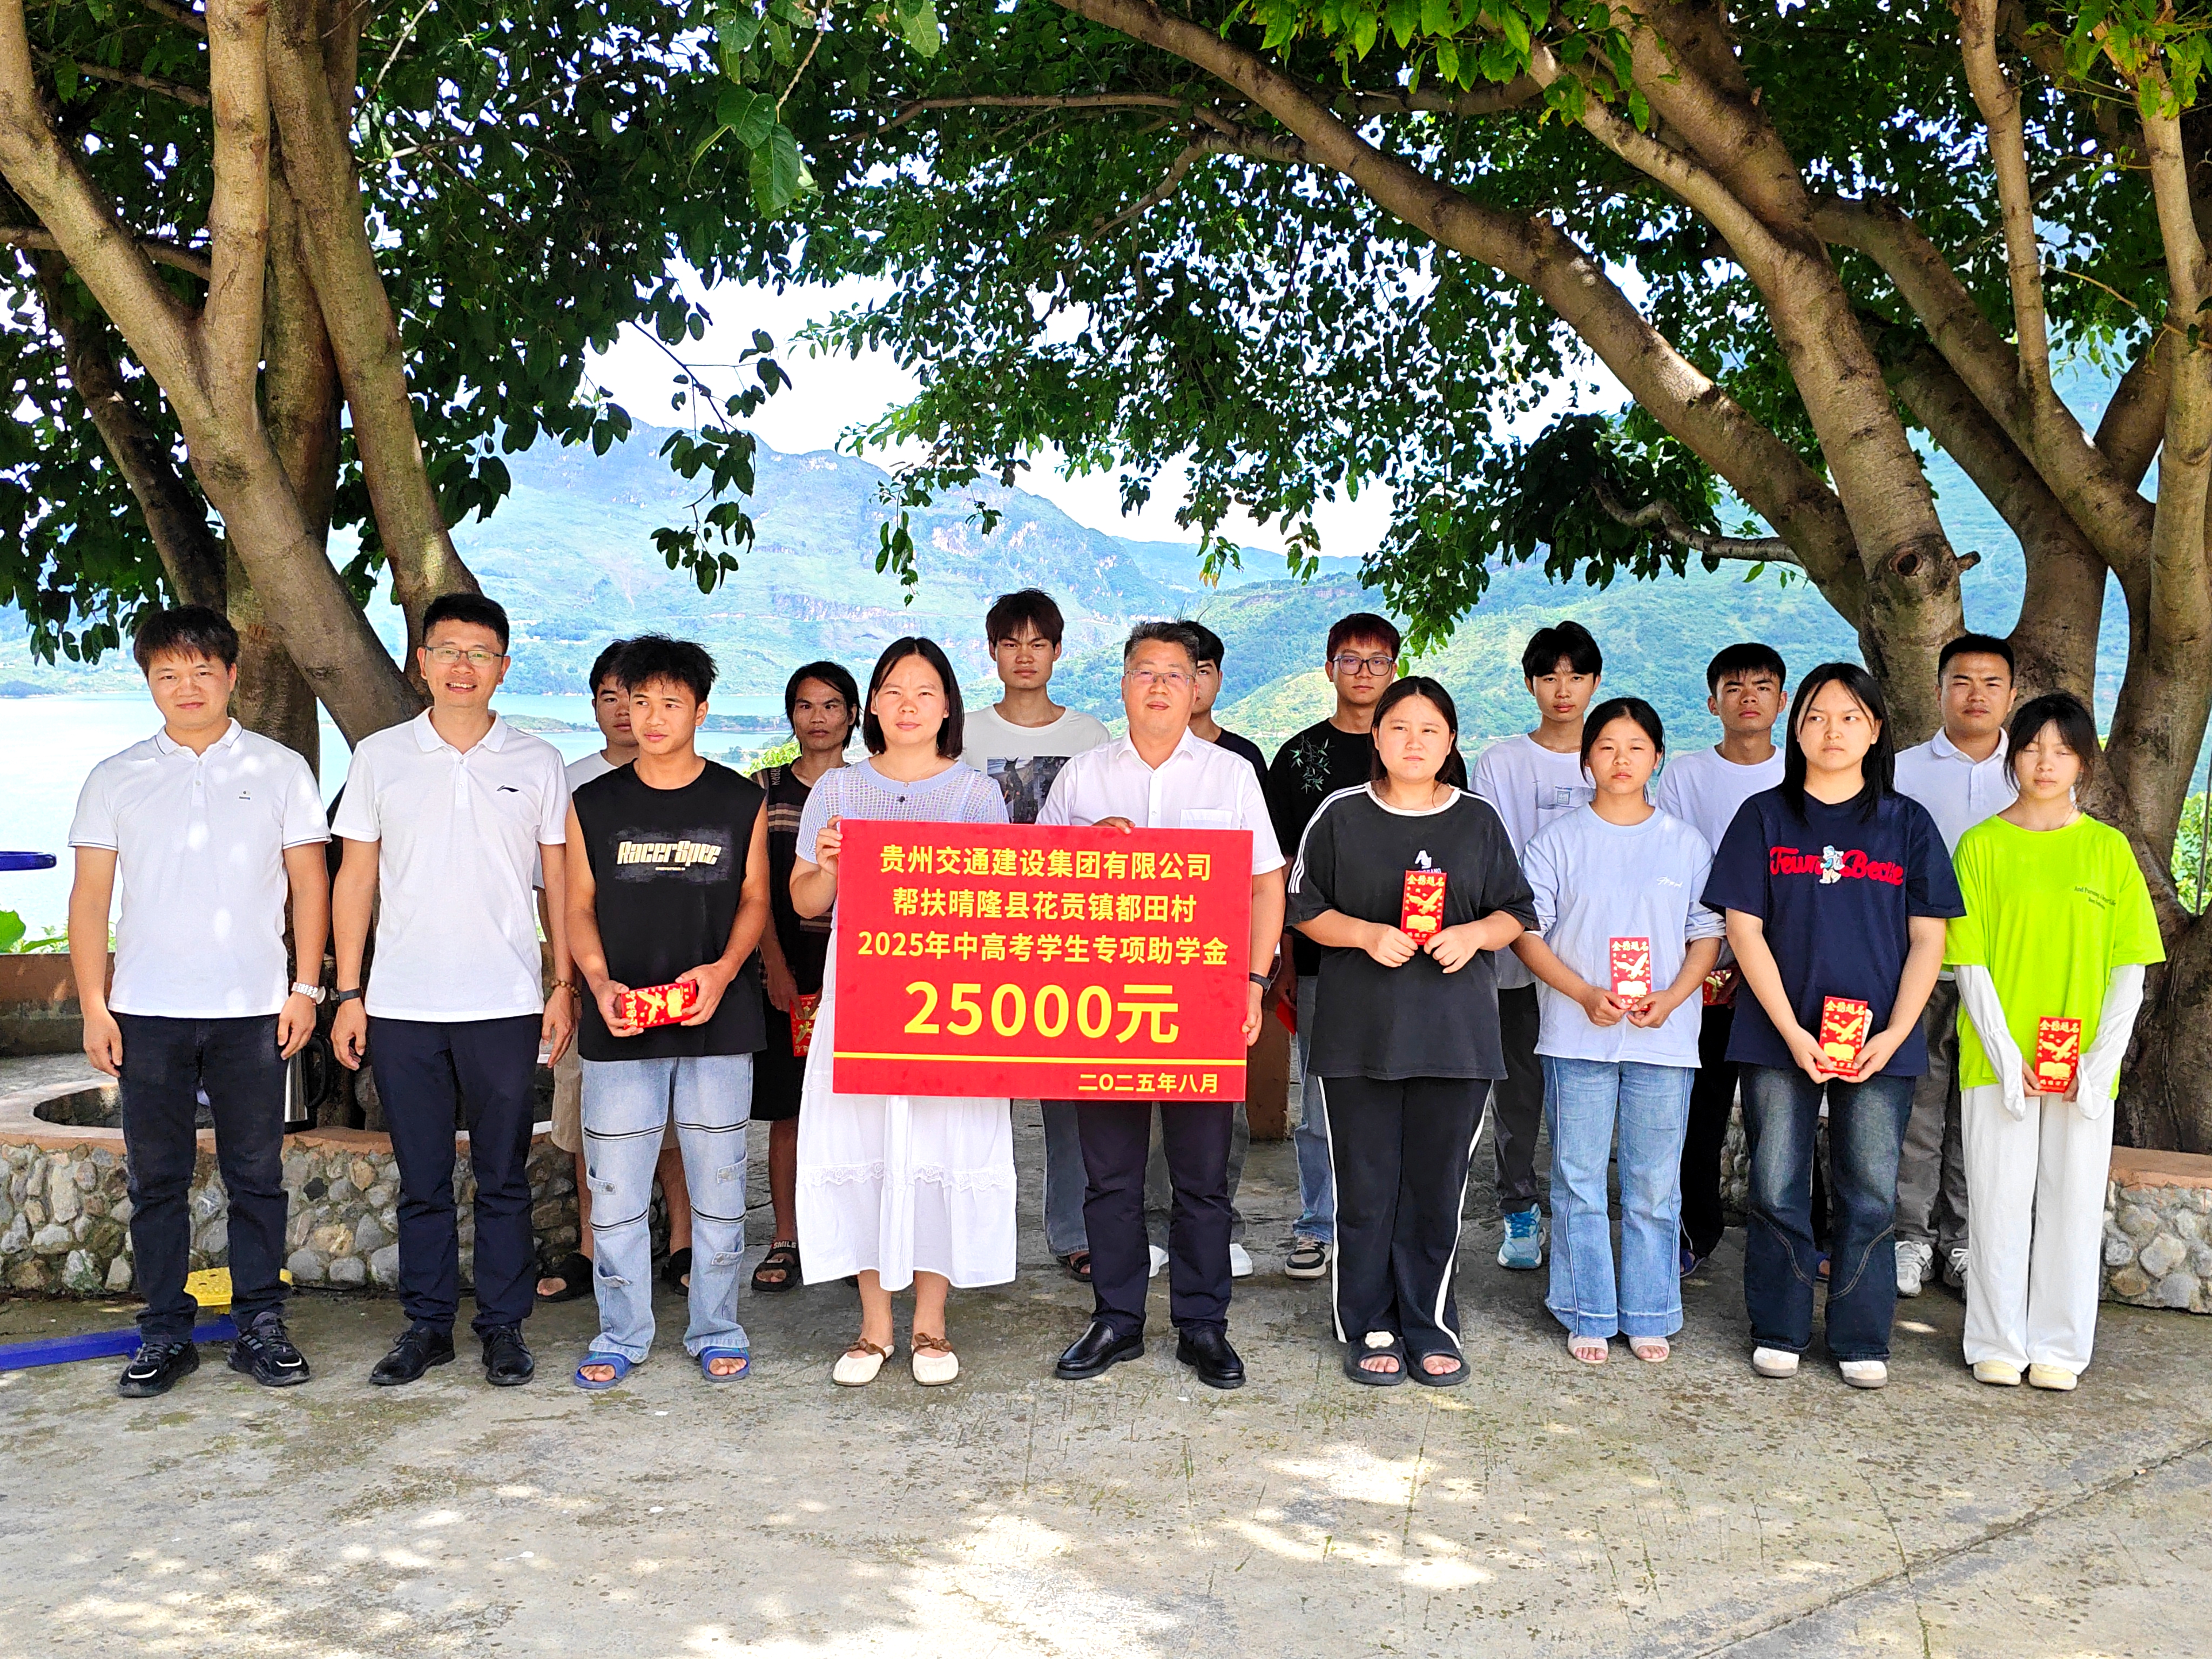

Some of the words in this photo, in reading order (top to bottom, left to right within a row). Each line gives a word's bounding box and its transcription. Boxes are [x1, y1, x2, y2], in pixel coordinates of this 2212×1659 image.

[880, 844, 1211, 881] 贵州交通建设集团有限公司
[893, 887, 1197, 923] 帮扶晴隆县花贡镇都田村
[858, 930, 1229, 966] 2025年中高考学生专项助学金
[904, 981, 1180, 1044] 25000元
